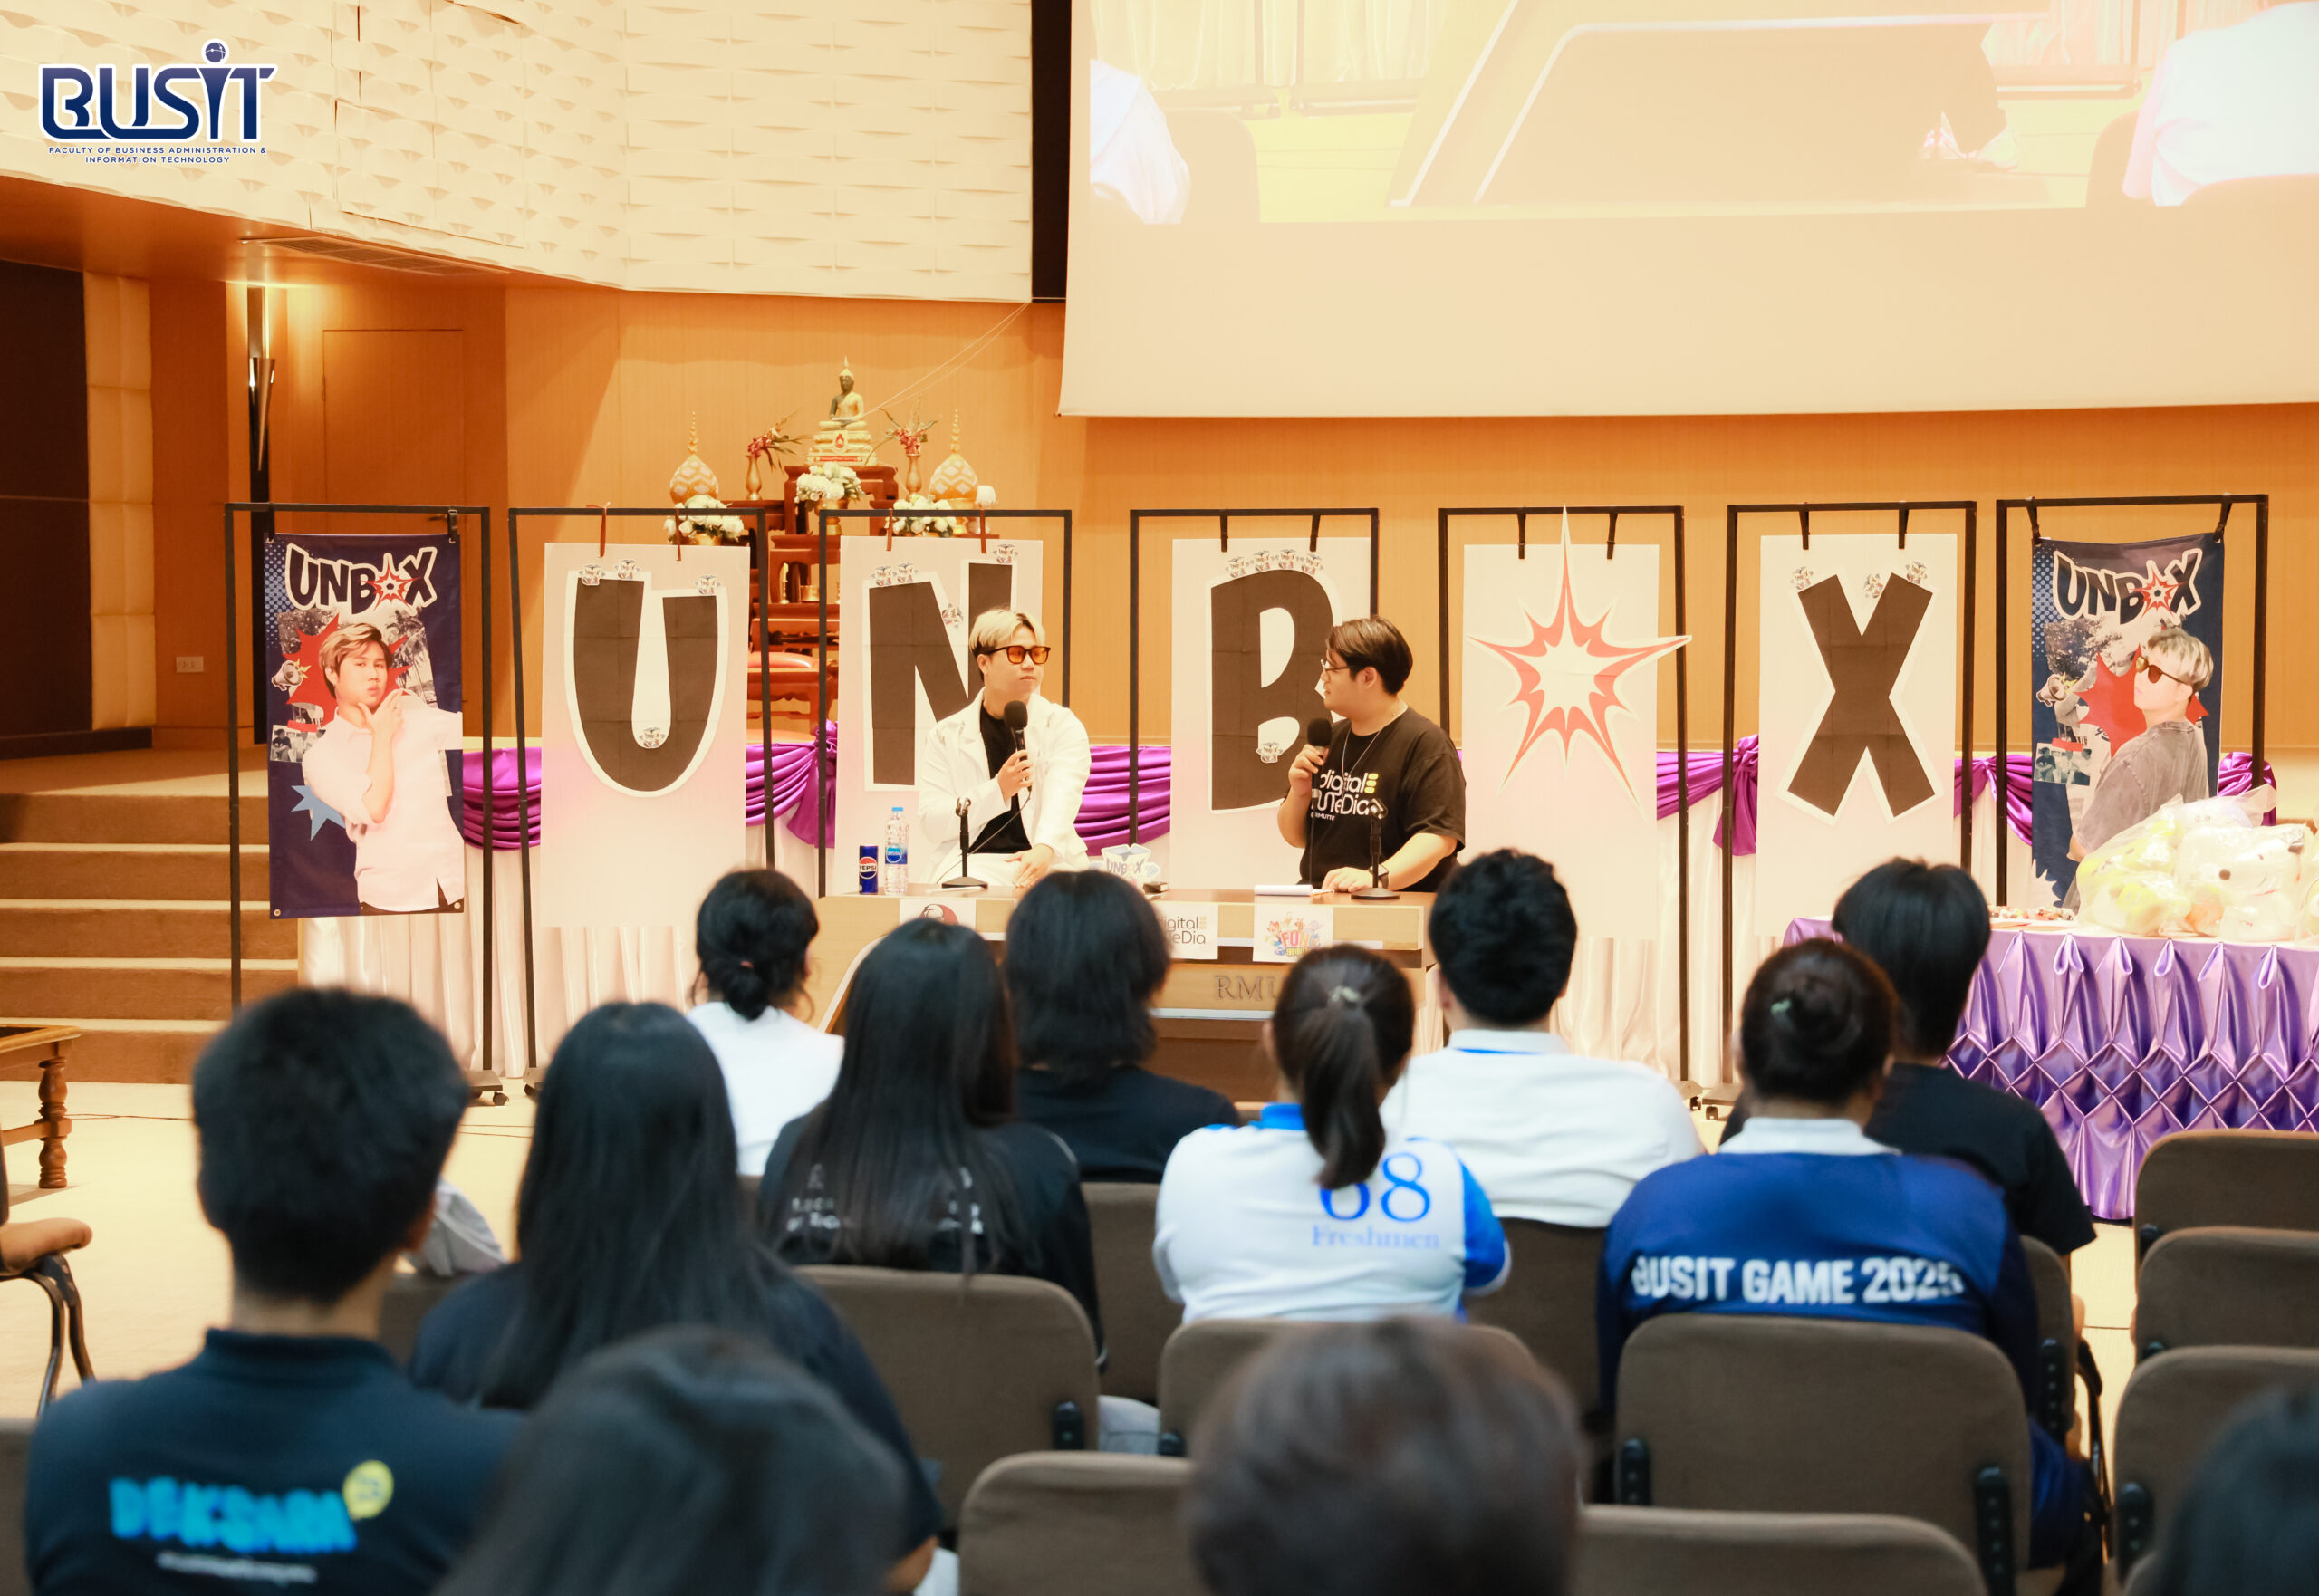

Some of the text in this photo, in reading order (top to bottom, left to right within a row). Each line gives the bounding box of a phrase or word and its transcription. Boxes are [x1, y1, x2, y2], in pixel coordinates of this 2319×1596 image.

[1162, 916, 1198, 932] igital
[1281, 930, 1310, 947] FUN
[1313, 1226, 1439, 1249] Freshmen
[1742, 1259, 1856, 1304] GAME
